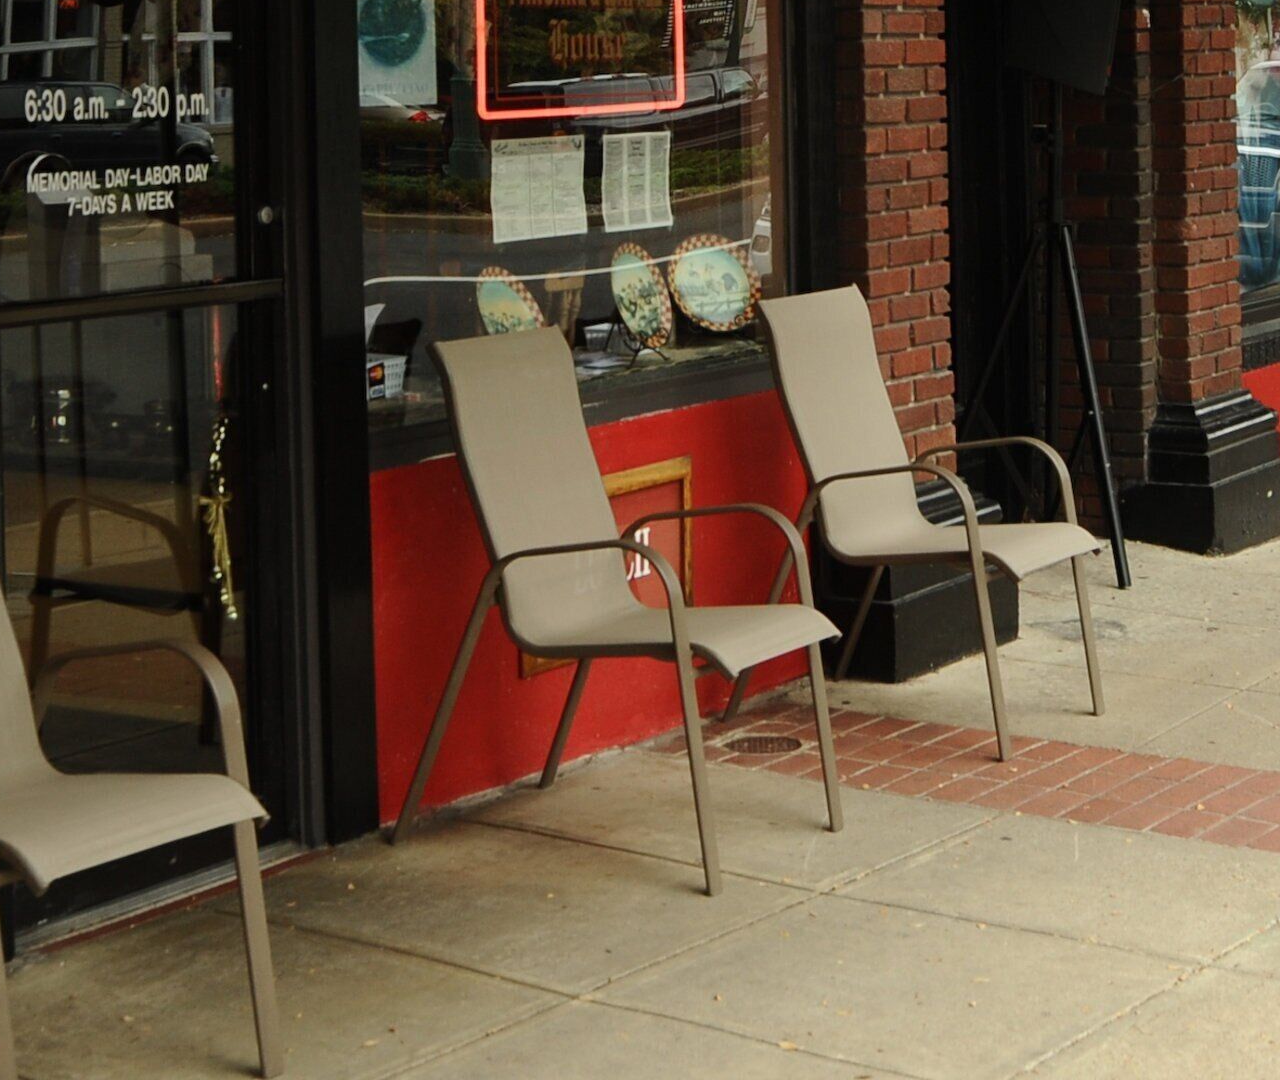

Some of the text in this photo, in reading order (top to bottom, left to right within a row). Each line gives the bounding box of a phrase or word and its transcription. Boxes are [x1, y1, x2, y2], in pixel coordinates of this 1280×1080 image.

[24, 88, 67, 124] 6:30
[73, 93, 109, 121] a.m.
[131, 86, 170, 120] 2:30
[175, 89, 210, 121] p.m.
[26, 163, 210, 194] MEMORIAL DAY-LABOR DAY
[66, 190, 175, 218] 7-DAYS A WEEK
